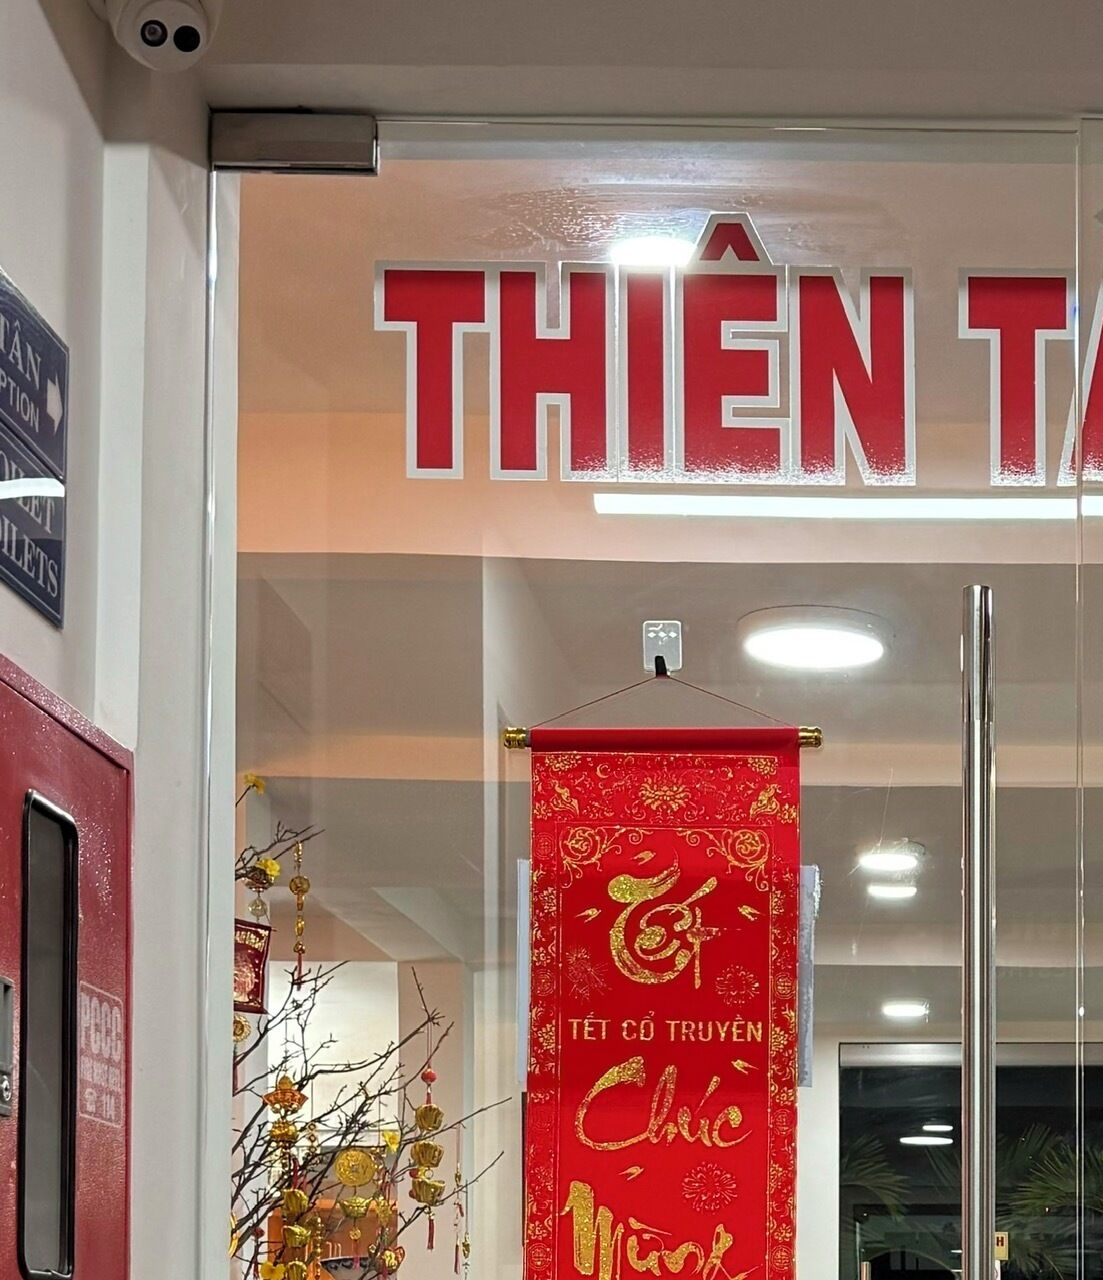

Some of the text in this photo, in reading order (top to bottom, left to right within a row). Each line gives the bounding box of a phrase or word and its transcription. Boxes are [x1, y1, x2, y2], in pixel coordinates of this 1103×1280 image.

[374, 211, 916, 487] THIÊN
[0, 367, 39, 433] PTION
[0, 514, 58, 598] ILETS
[607, 849, 723, 990] Tết
[80, 991, 122, 1063] PCCC
[568, 1010, 763, 1043] TẾT CỔ TRUYỀN
[576, 1056, 752, 1150] Chúc
